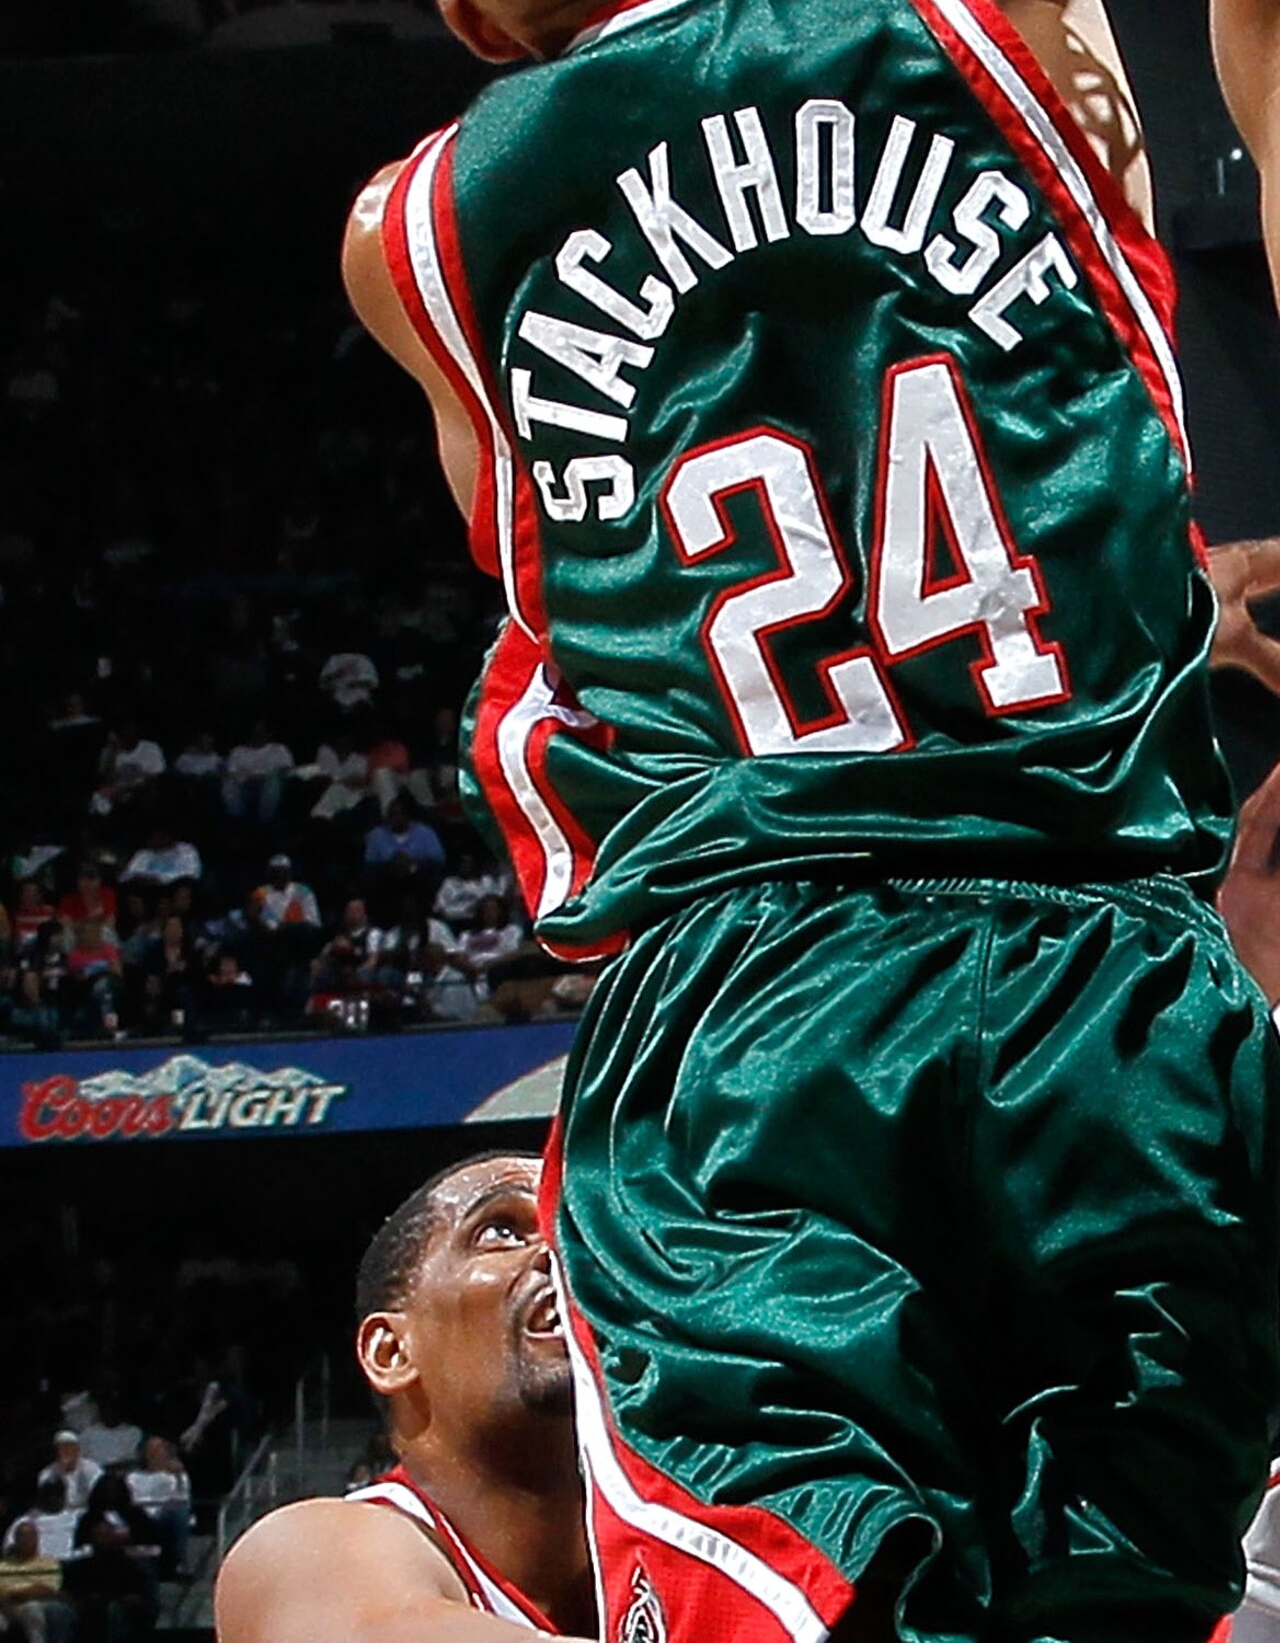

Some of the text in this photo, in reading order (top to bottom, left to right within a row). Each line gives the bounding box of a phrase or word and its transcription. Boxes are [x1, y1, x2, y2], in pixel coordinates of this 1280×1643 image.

[510, 98, 1079, 524] STACKHOUSE
[660, 352, 1072, 759] 24
[19, 1074, 346, 1141] Coors LIGHT
